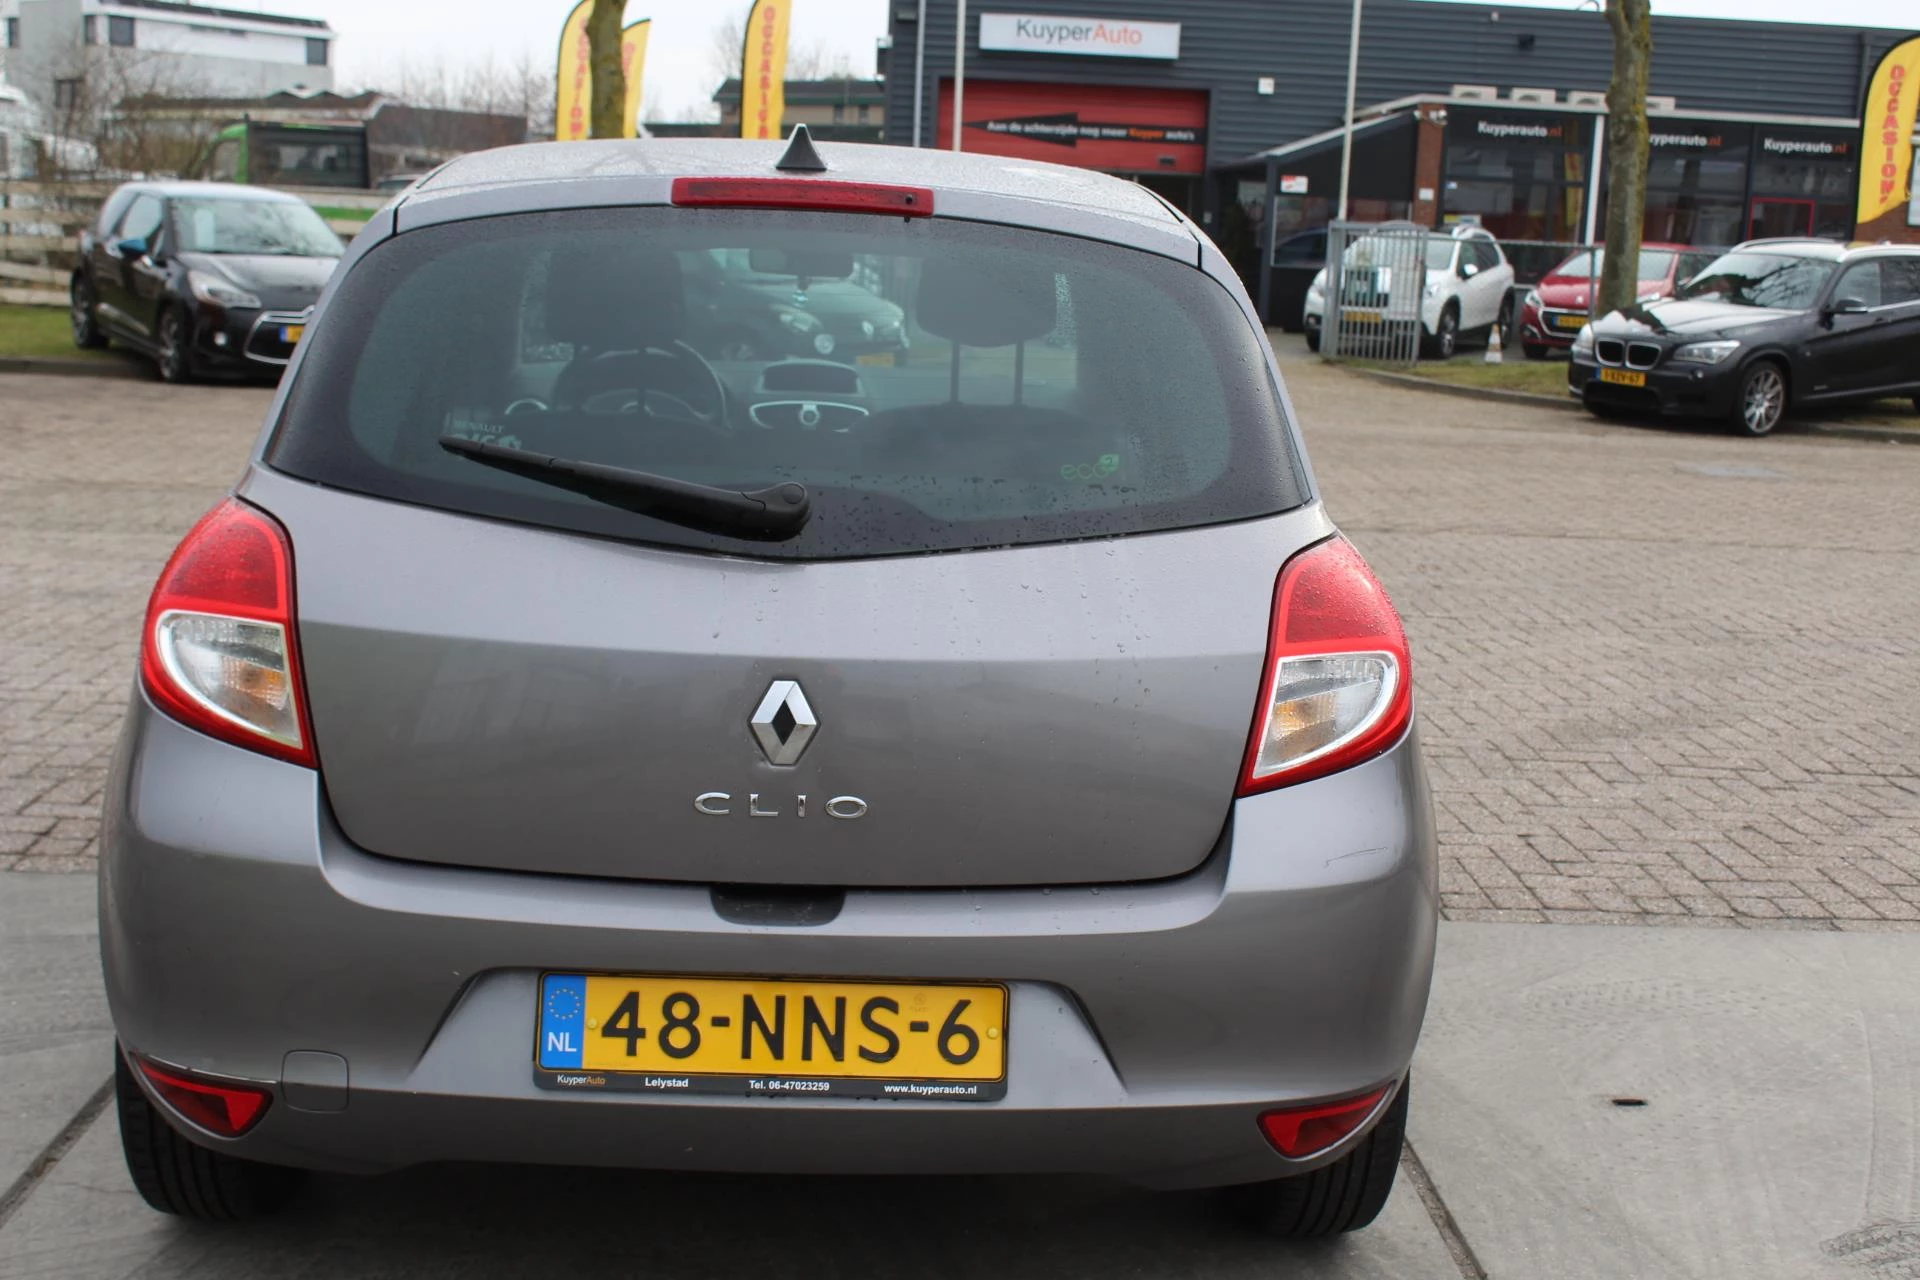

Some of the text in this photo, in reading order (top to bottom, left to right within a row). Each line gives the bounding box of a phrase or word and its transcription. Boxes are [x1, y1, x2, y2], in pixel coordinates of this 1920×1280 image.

[1016, 18, 1143, 46] KuyperAuto
[1478, 120, 1562, 137] Kuyperauto.nl
[1764, 137, 1848, 154] Kuyperauto.nl
[694, 791, 868, 819] CLIO
[601, 991, 980, 1065] 48-NNS-6
[548, 1032, 577, 1052] NL
[557, 1074, 977, 1096] KuyperAuto Lelystad Tel. 06-47023259 www.kuyperauto.nl
